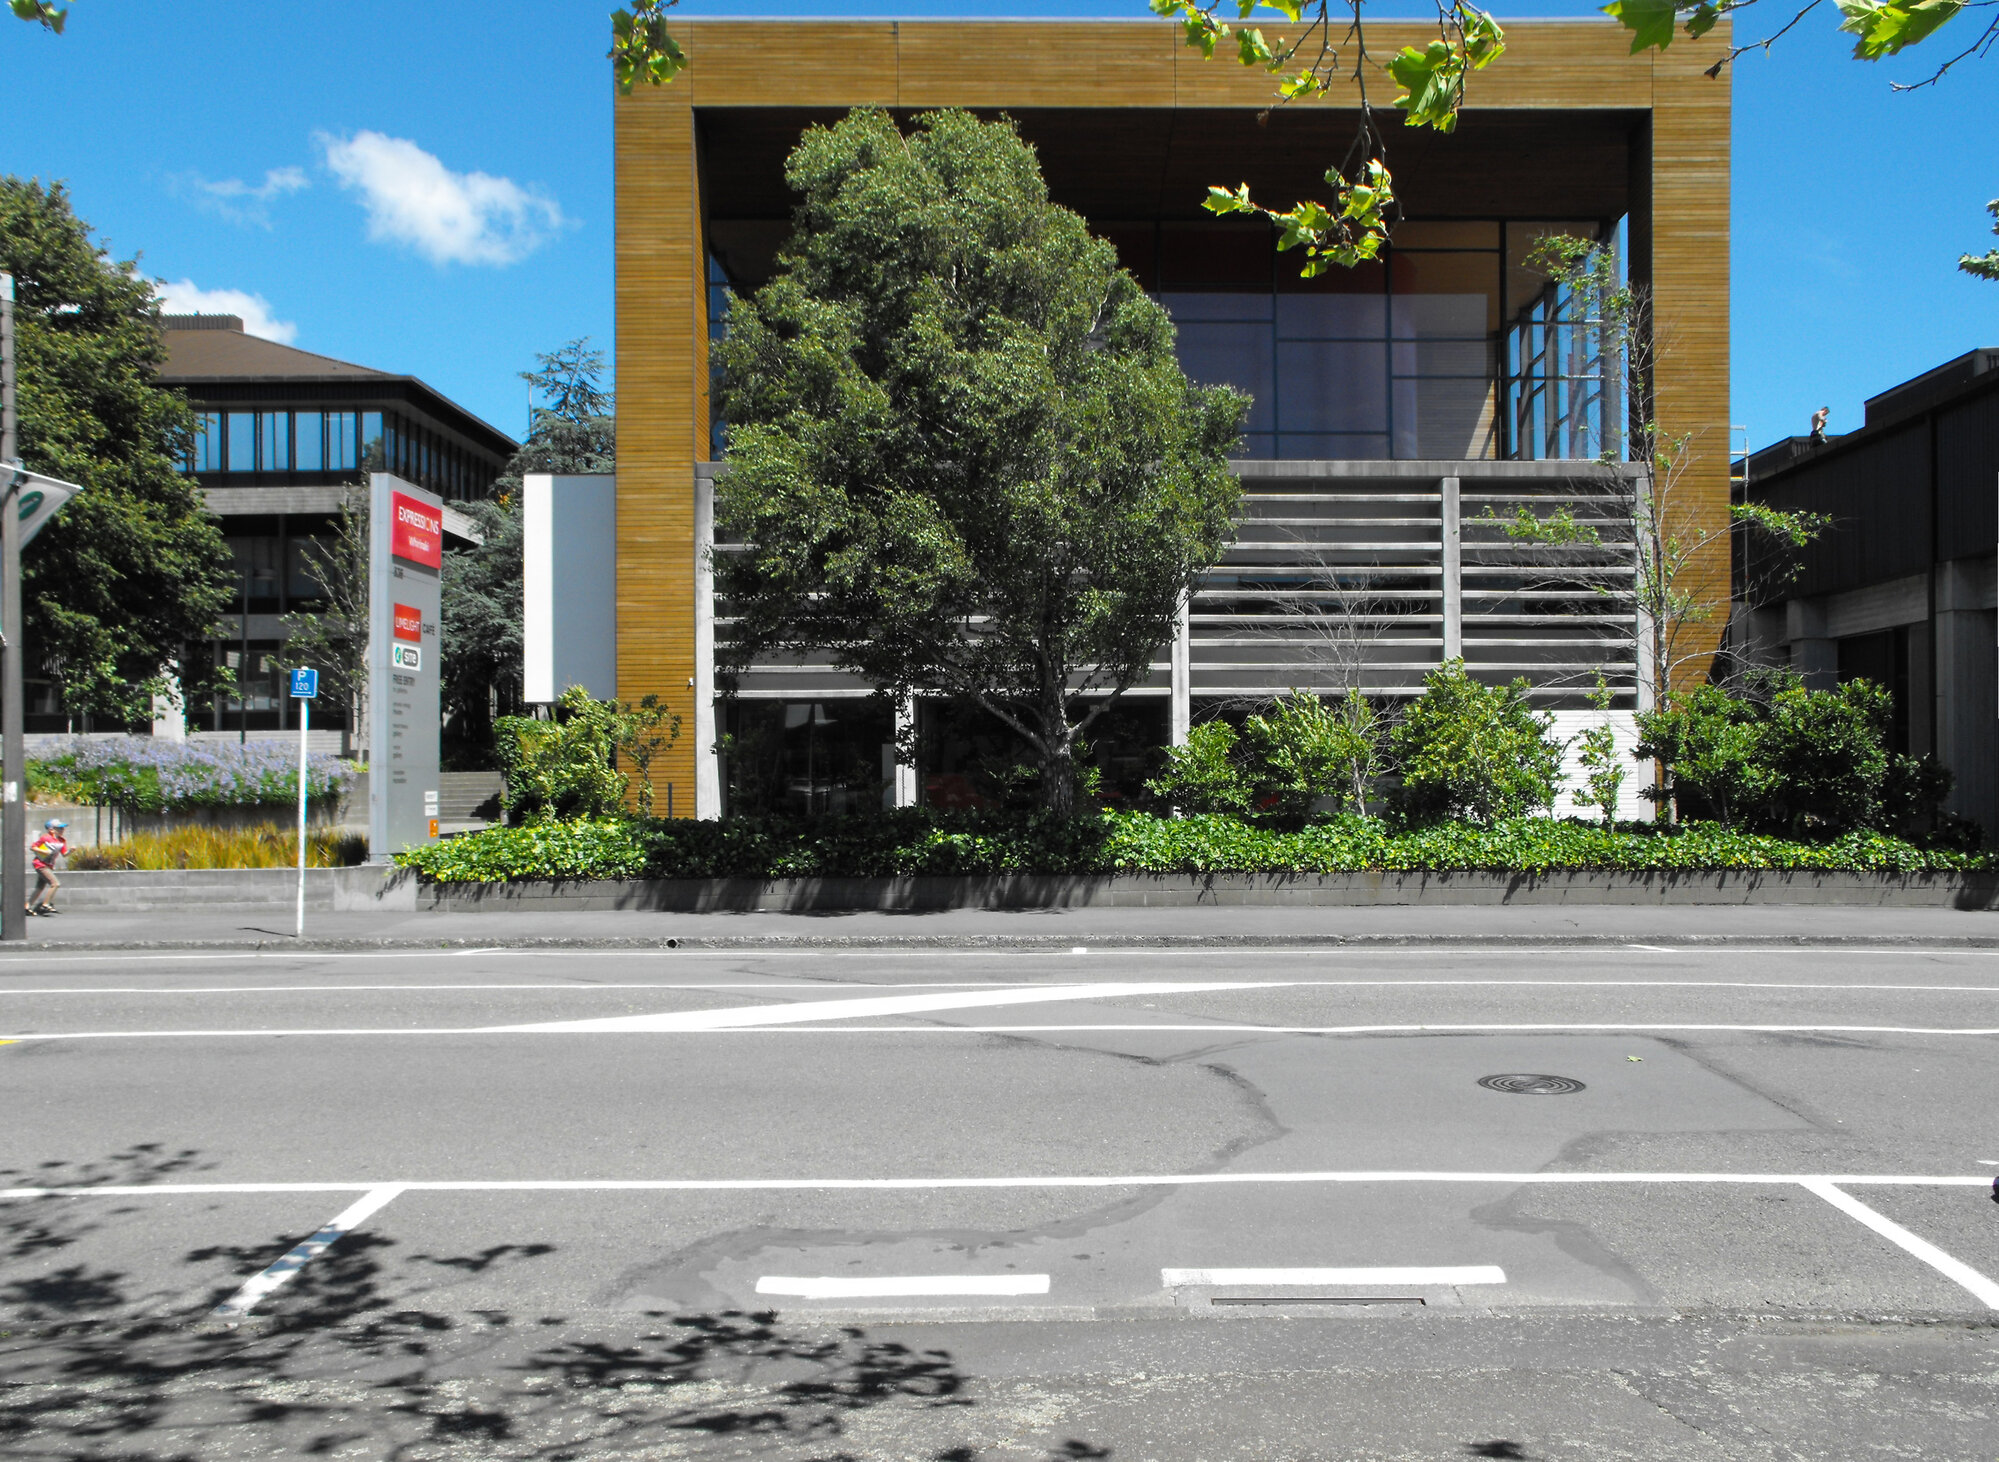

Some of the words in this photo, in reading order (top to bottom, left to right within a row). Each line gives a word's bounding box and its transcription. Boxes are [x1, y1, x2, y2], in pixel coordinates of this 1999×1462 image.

[398, 505, 439, 535] EXPRESSIONS
[297, 670, 307, 681] P
[295, 682, 309, 691] 120
